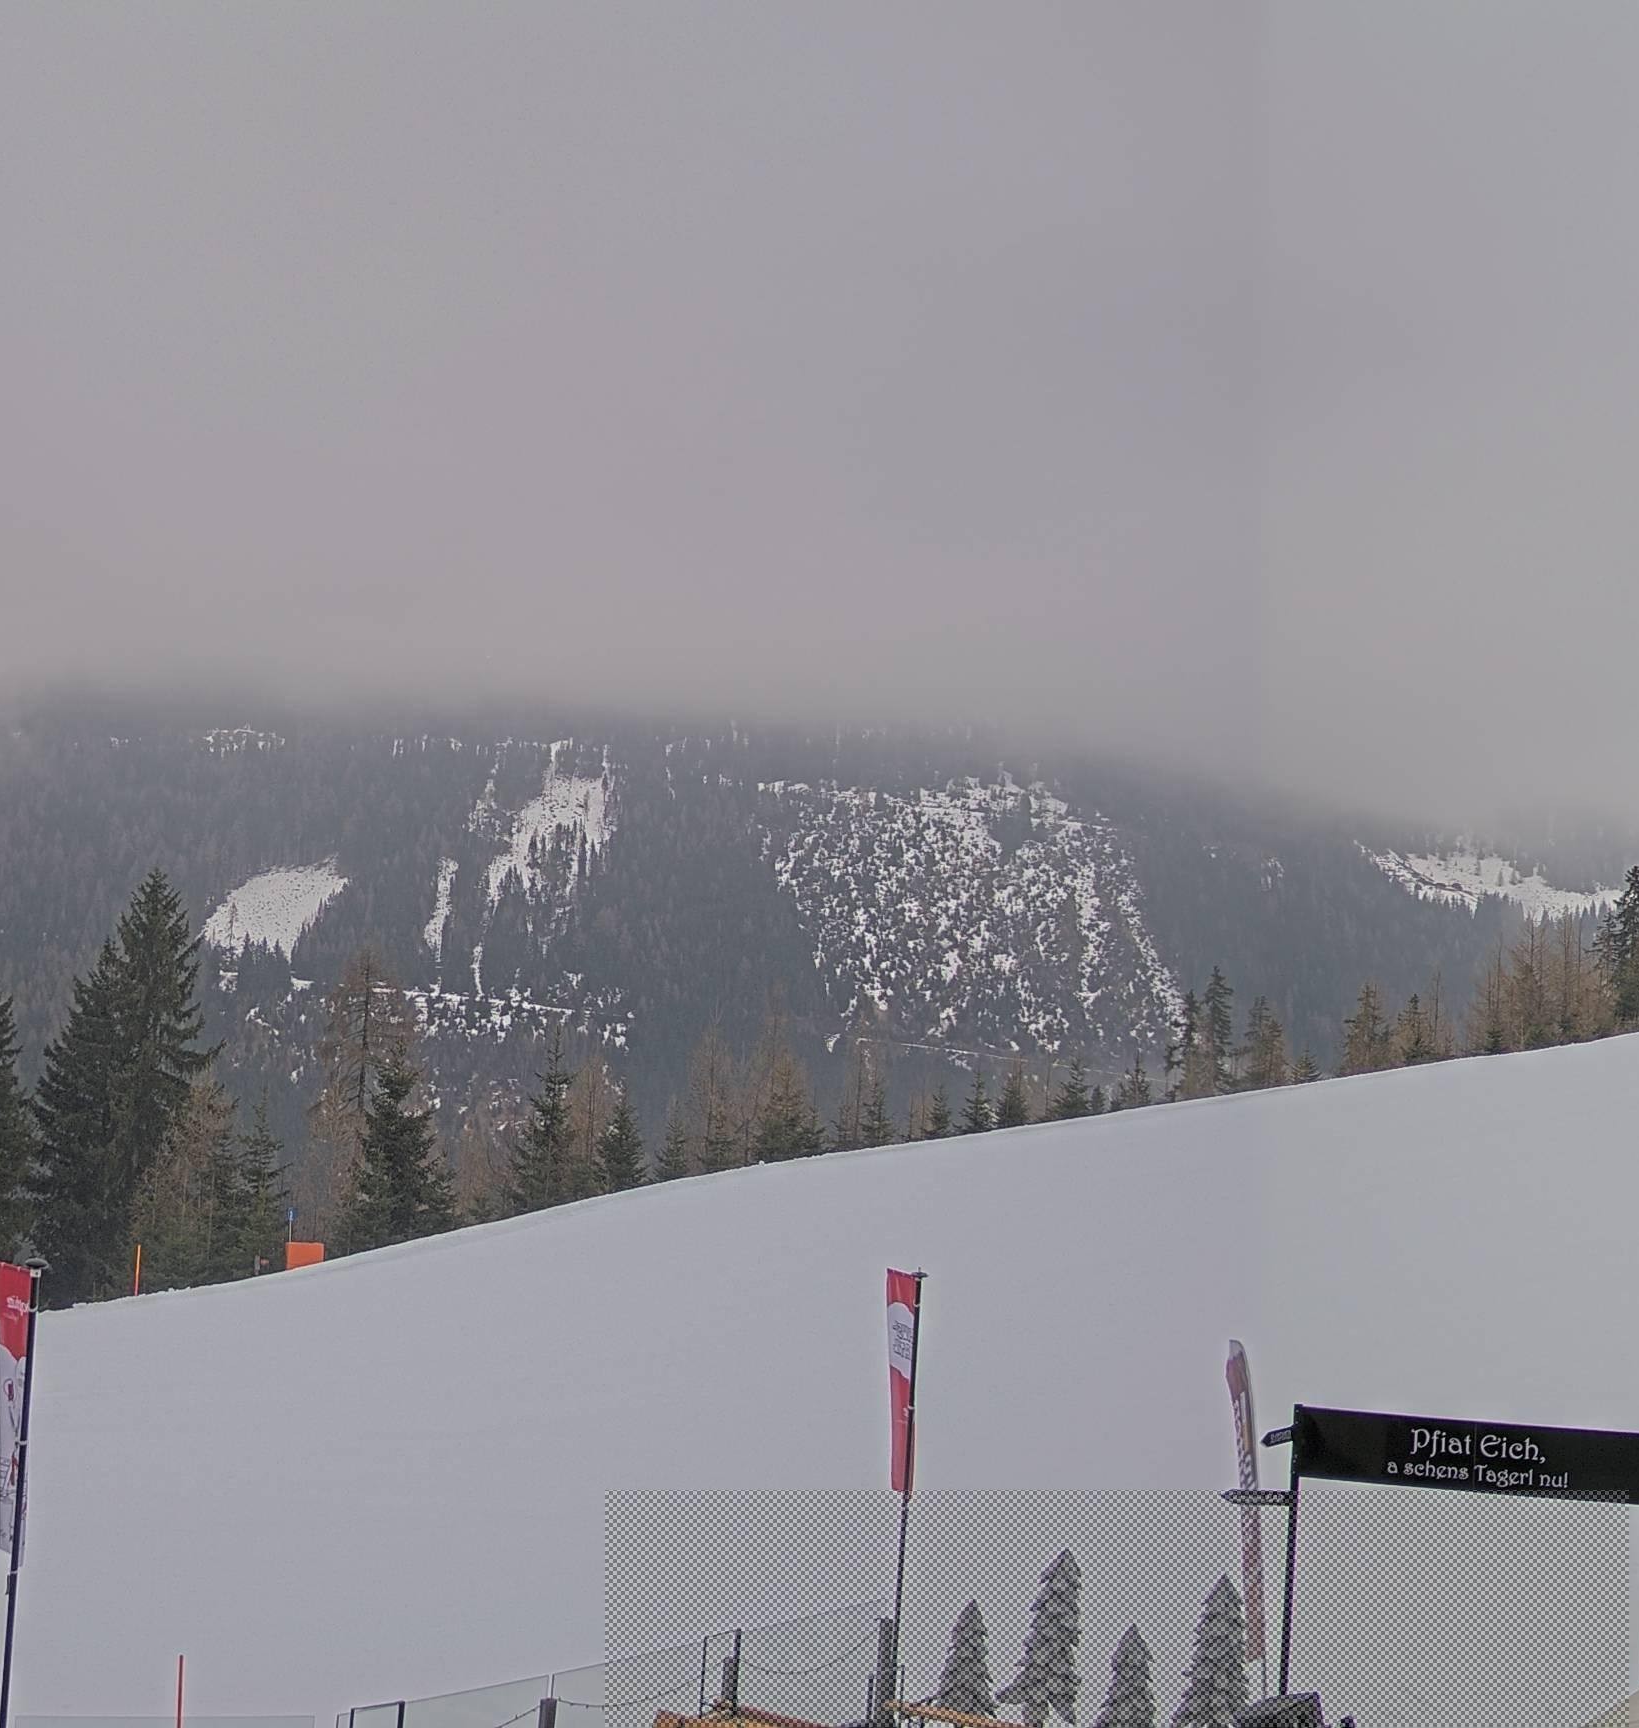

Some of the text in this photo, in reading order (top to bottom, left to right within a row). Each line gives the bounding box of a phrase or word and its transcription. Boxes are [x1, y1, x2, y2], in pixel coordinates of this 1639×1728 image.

[1410, 1428, 1547, 1464] Pfiat Eich,
[1387, 1460, 1570, 1488] a schens Tagerl nu!
